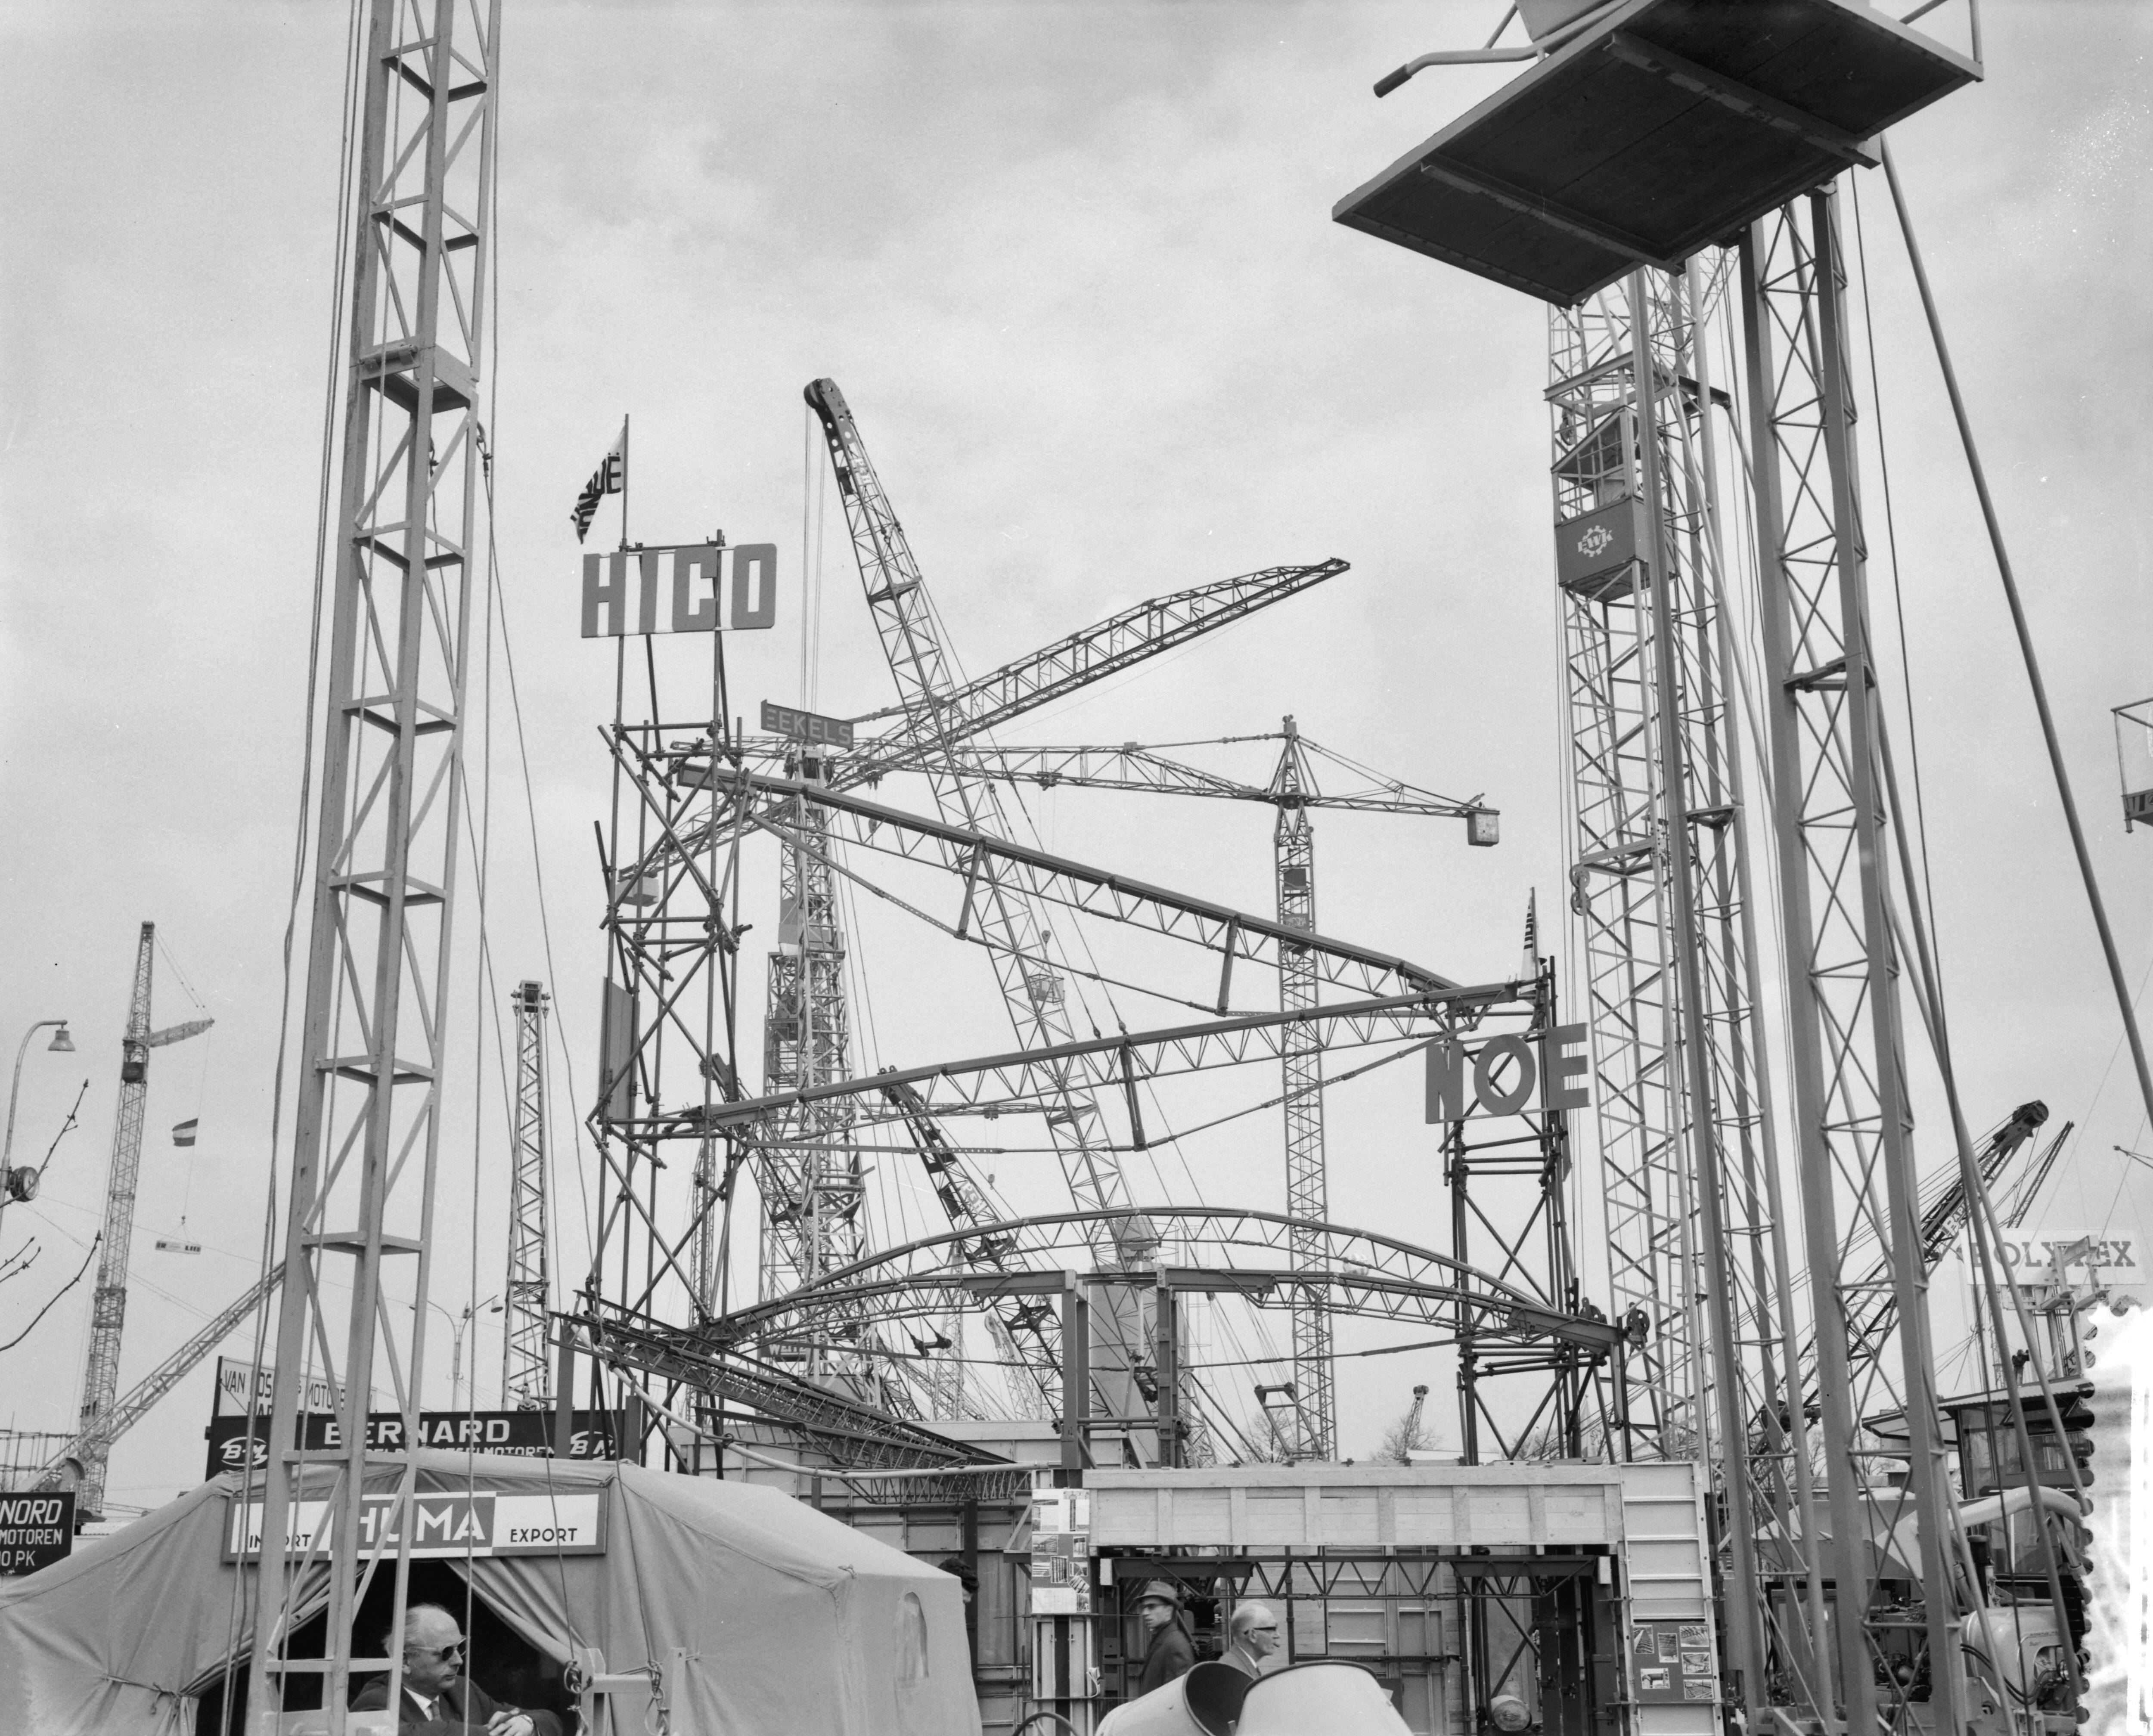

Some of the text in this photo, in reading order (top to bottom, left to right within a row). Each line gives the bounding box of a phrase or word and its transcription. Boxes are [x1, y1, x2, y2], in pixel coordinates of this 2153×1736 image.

[1577, 530, 1613, 553] EWK
[581, 543, 777, 638] HICO
[766, 708, 851, 745] EEKELS
[1426, 1023, 1590, 1124] NOE
[226, 1370, 245, 1394] VAN
[0, 1500, 62, 1524] NORD
[249, 1534, 311, 1548] IRT
[510, 1528, 577, 1543] EXPORT
[16, 1551, 35, 1566] PK
